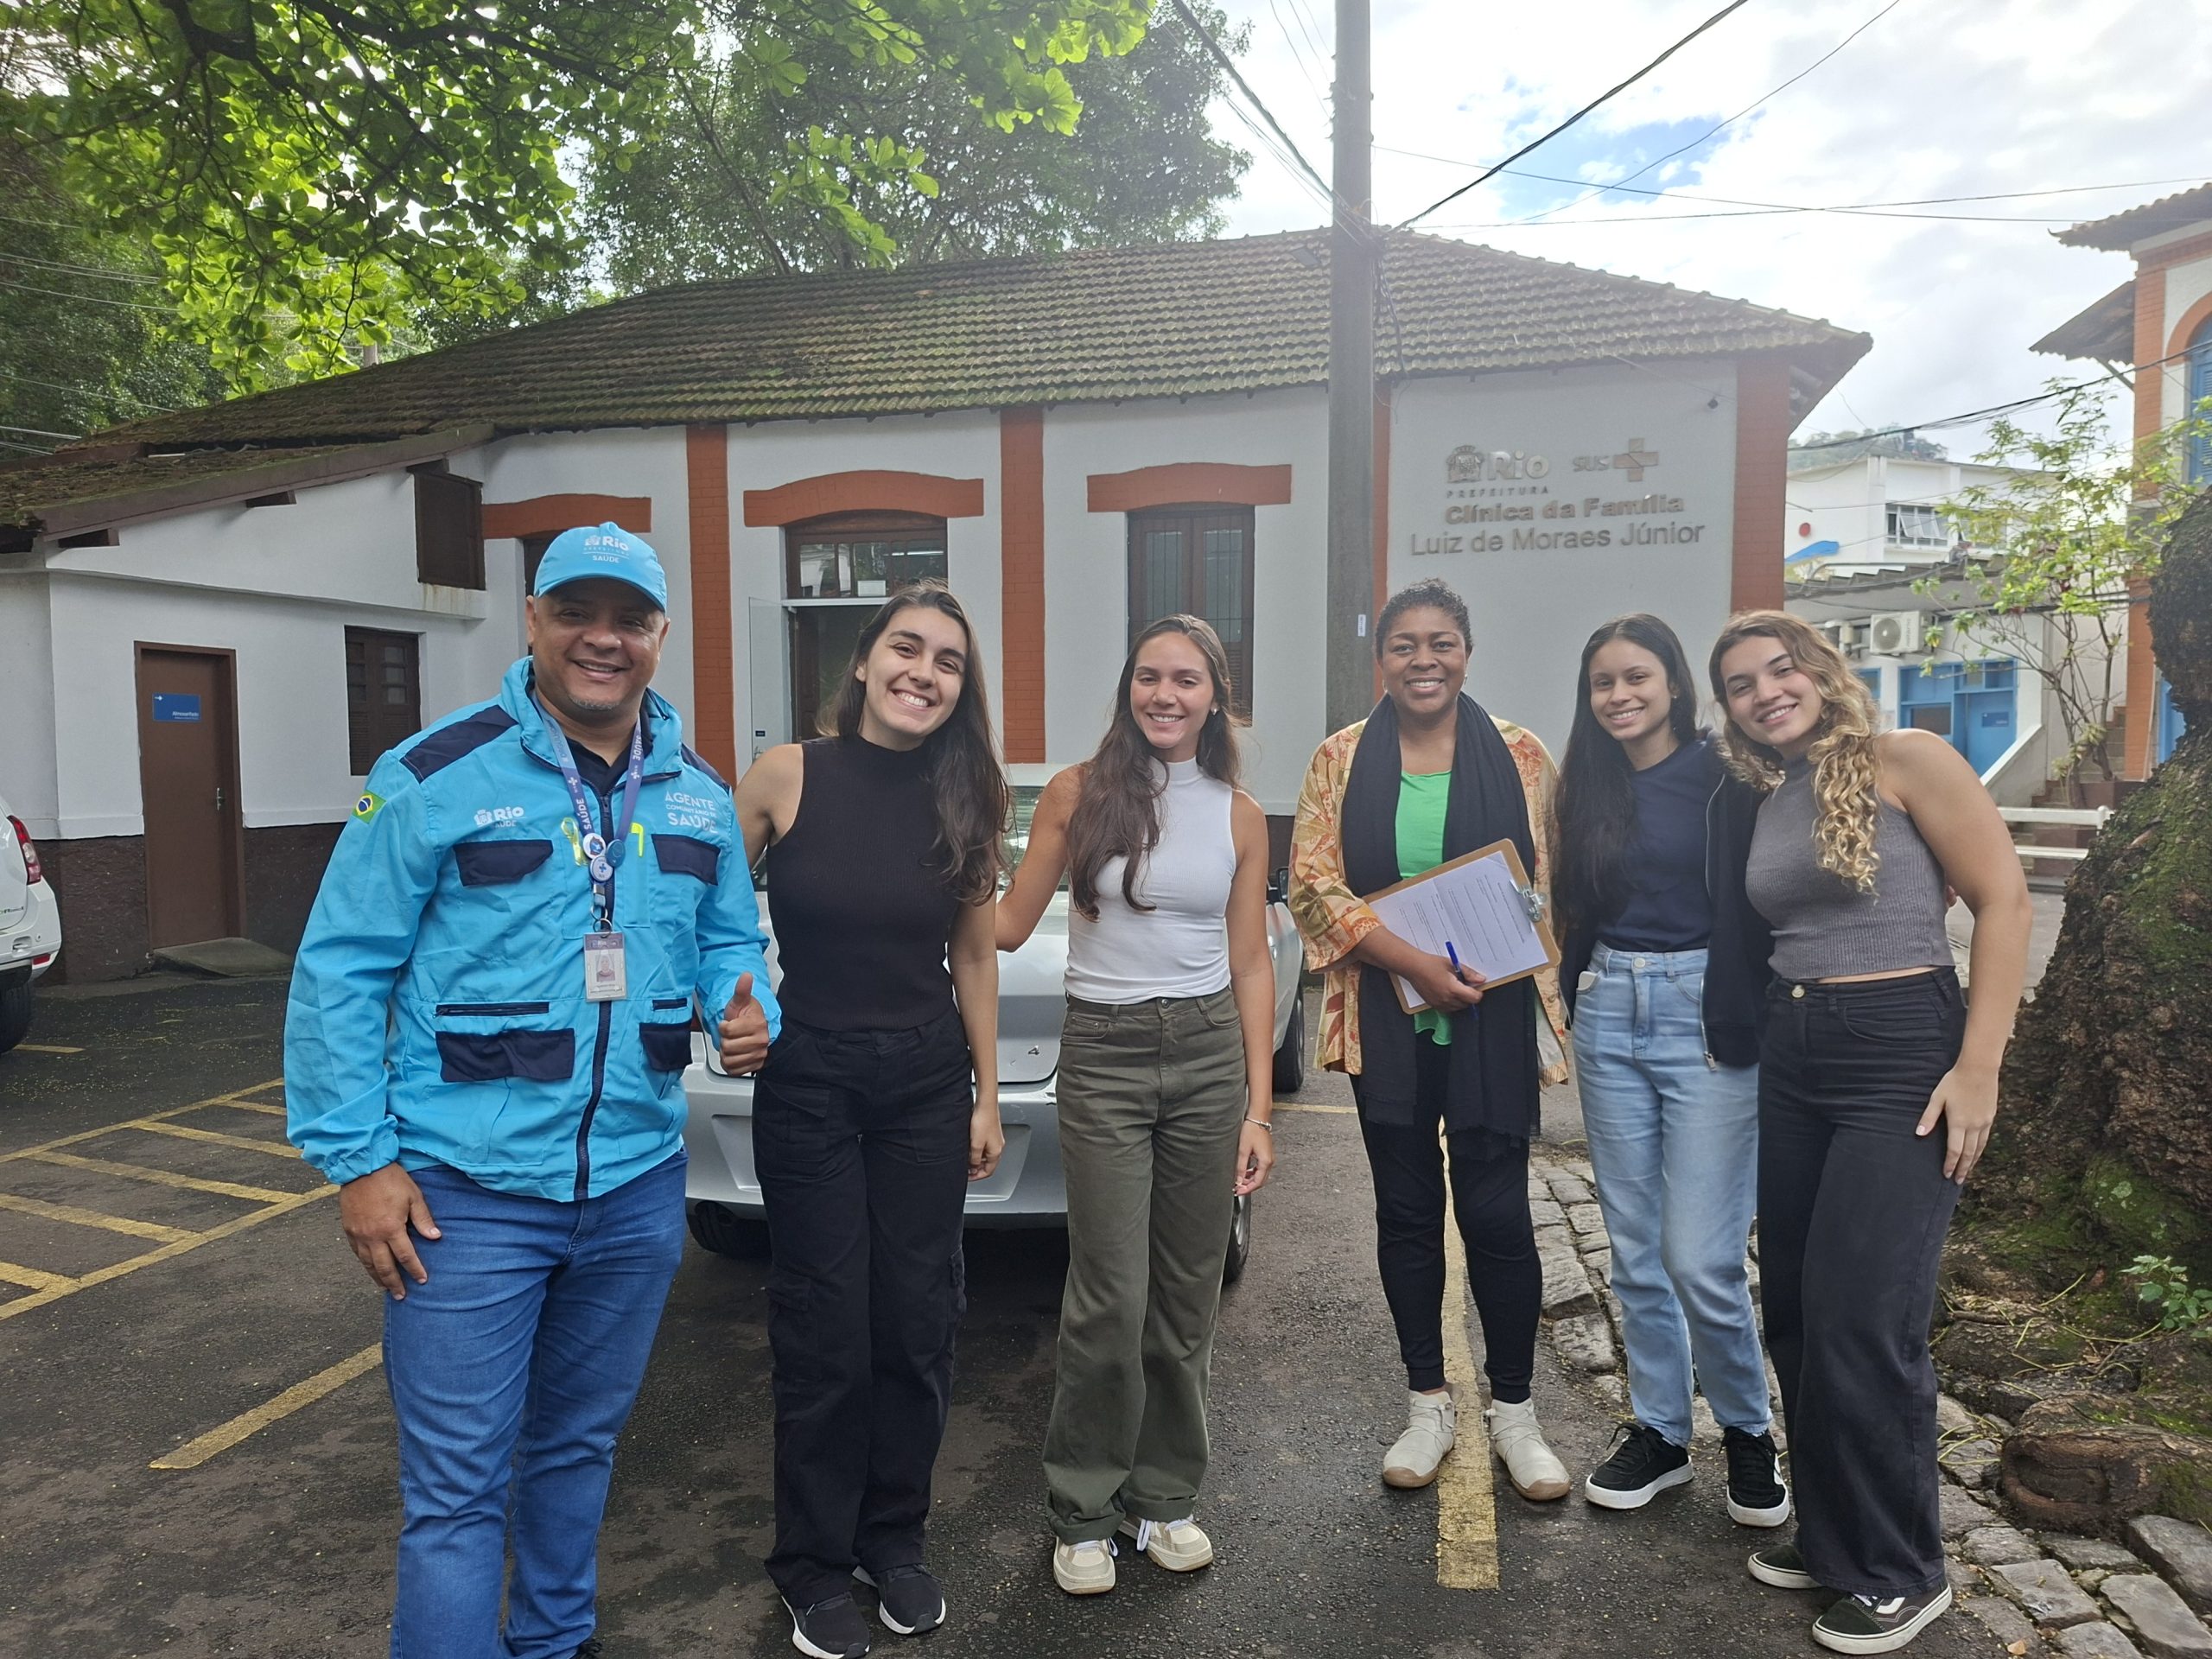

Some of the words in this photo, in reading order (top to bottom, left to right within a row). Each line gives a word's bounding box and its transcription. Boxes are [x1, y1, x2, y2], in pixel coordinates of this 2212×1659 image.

[1487, 448, 1550, 481] Rio
[1572, 454, 1611, 473] SUS
[1446, 485, 1550, 499] PREFEITURA
[1445, 500, 1535, 525] Clínica
[1541, 500, 1576, 519] da
[1583, 493, 1686, 518] Família
[602, 536, 629, 551] Rio
[1410, 531, 1464, 556] Luiz
[1471, 529, 1504, 553] de
[1512, 526, 1611, 551] Moraes
[1620, 519, 1706, 547] Júnior
[664, 791, 716, 810] AGENTE
[493, 806, 524, 820] Rio
[575, 798, 594, 830] SAÚDE
[667, 812, 719, 834] SAÚDE
